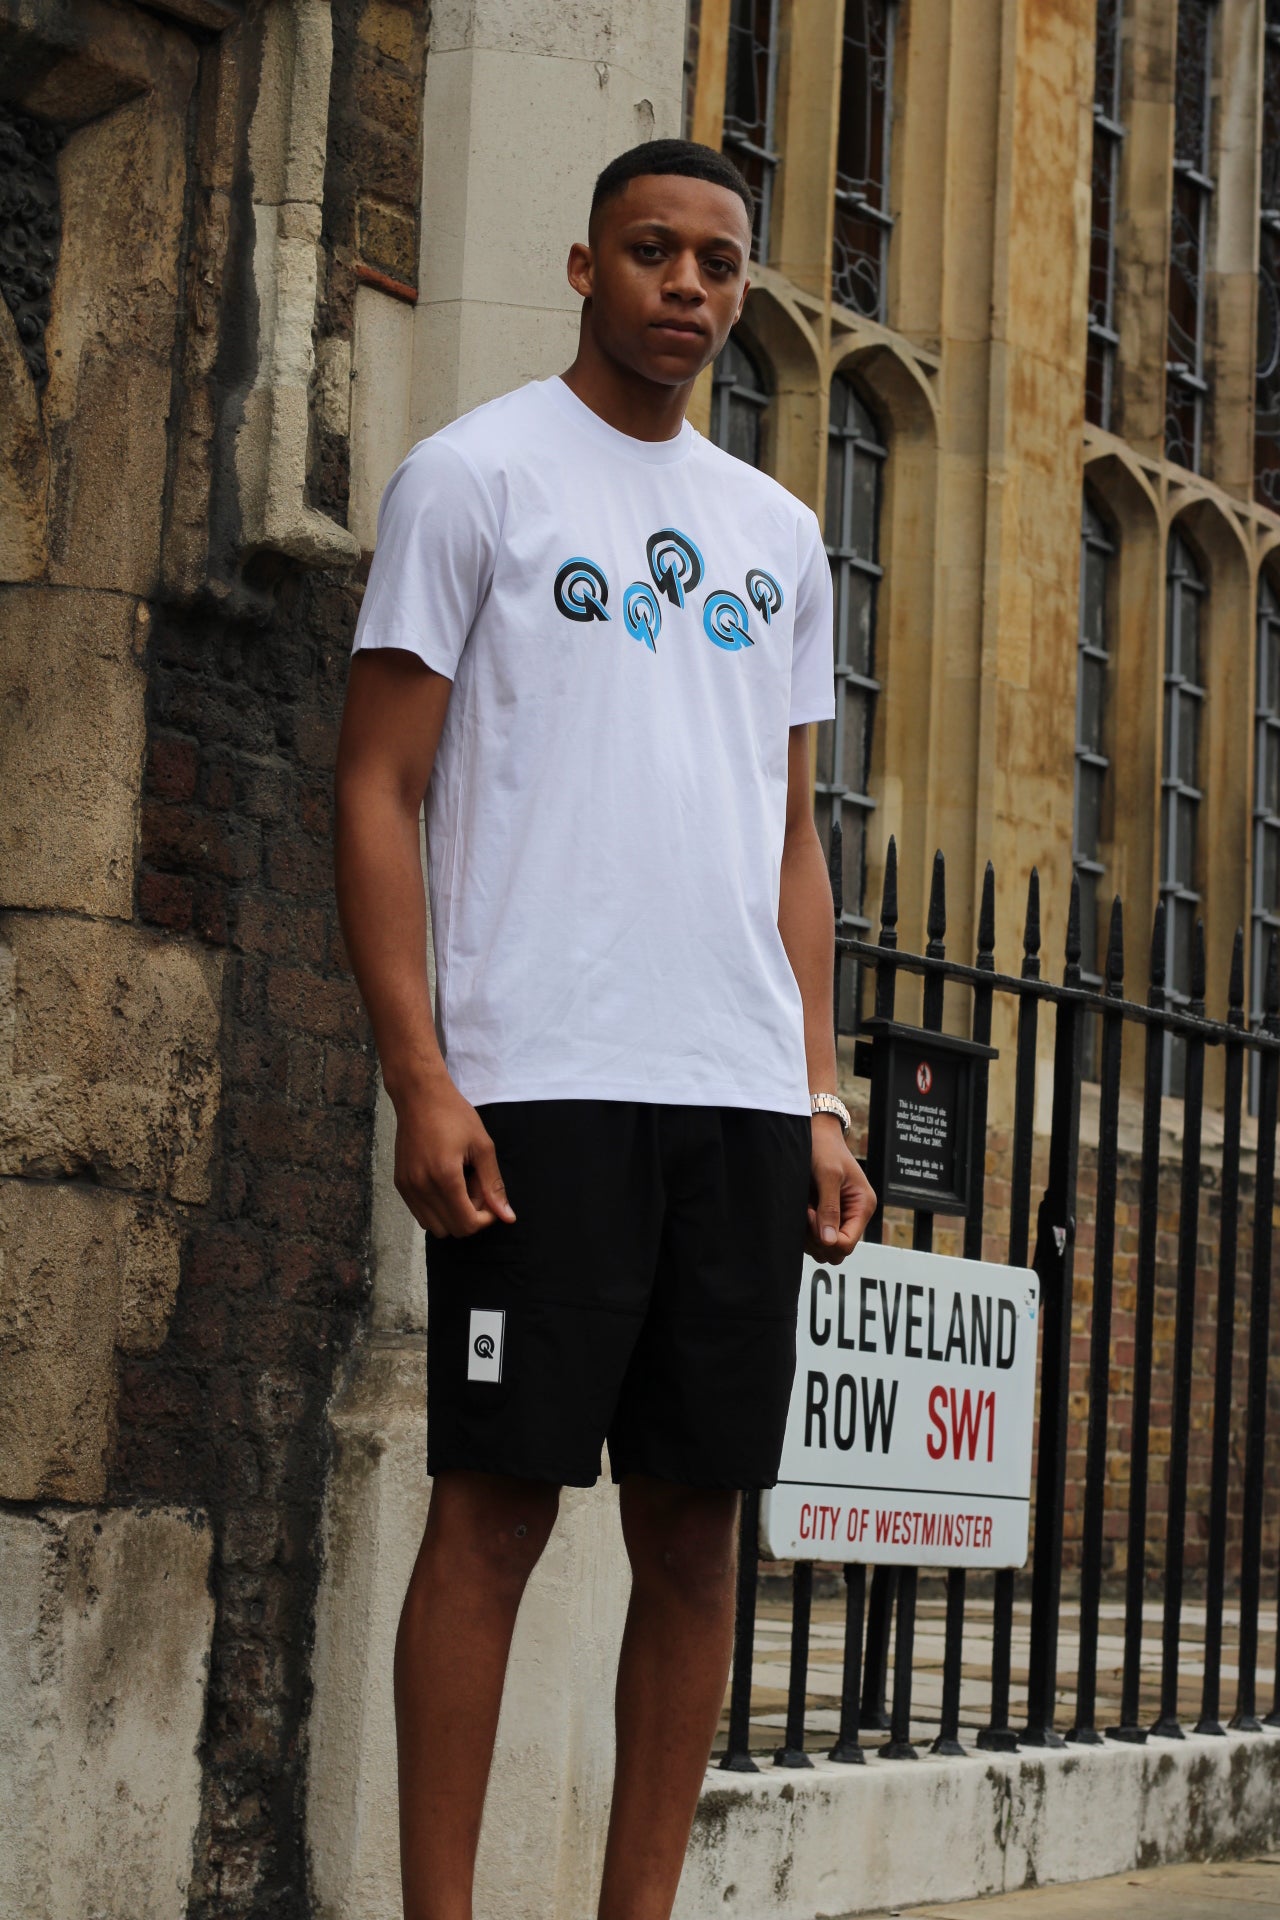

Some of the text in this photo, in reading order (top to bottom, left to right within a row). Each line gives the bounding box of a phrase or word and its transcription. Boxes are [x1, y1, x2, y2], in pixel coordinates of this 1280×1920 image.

[898, 1099, 908, 1108] This
[919, 1105, 938, 1115] protected
[897, 1111, 909, 1119] under
[910, 1112, 925, 1122] Section
[896, 1120, 911, 1130] Serious
[934, 1128, 947, 1138] Crime
[900, 1133, 908, 1141] and
[909, 1134, 921, 1143] Police
[922, 1137, 930, 1145] Act
[922, 1159, 930, 1168] this
[905, 1167, 921, 1177] criminal
[809, 1268, 1017, 1370] CLEVELAND
[804, 1370, 996, 1462] ROW SW1
[799, 1503, 993, 1548] CITY OF WESTMINSTER
